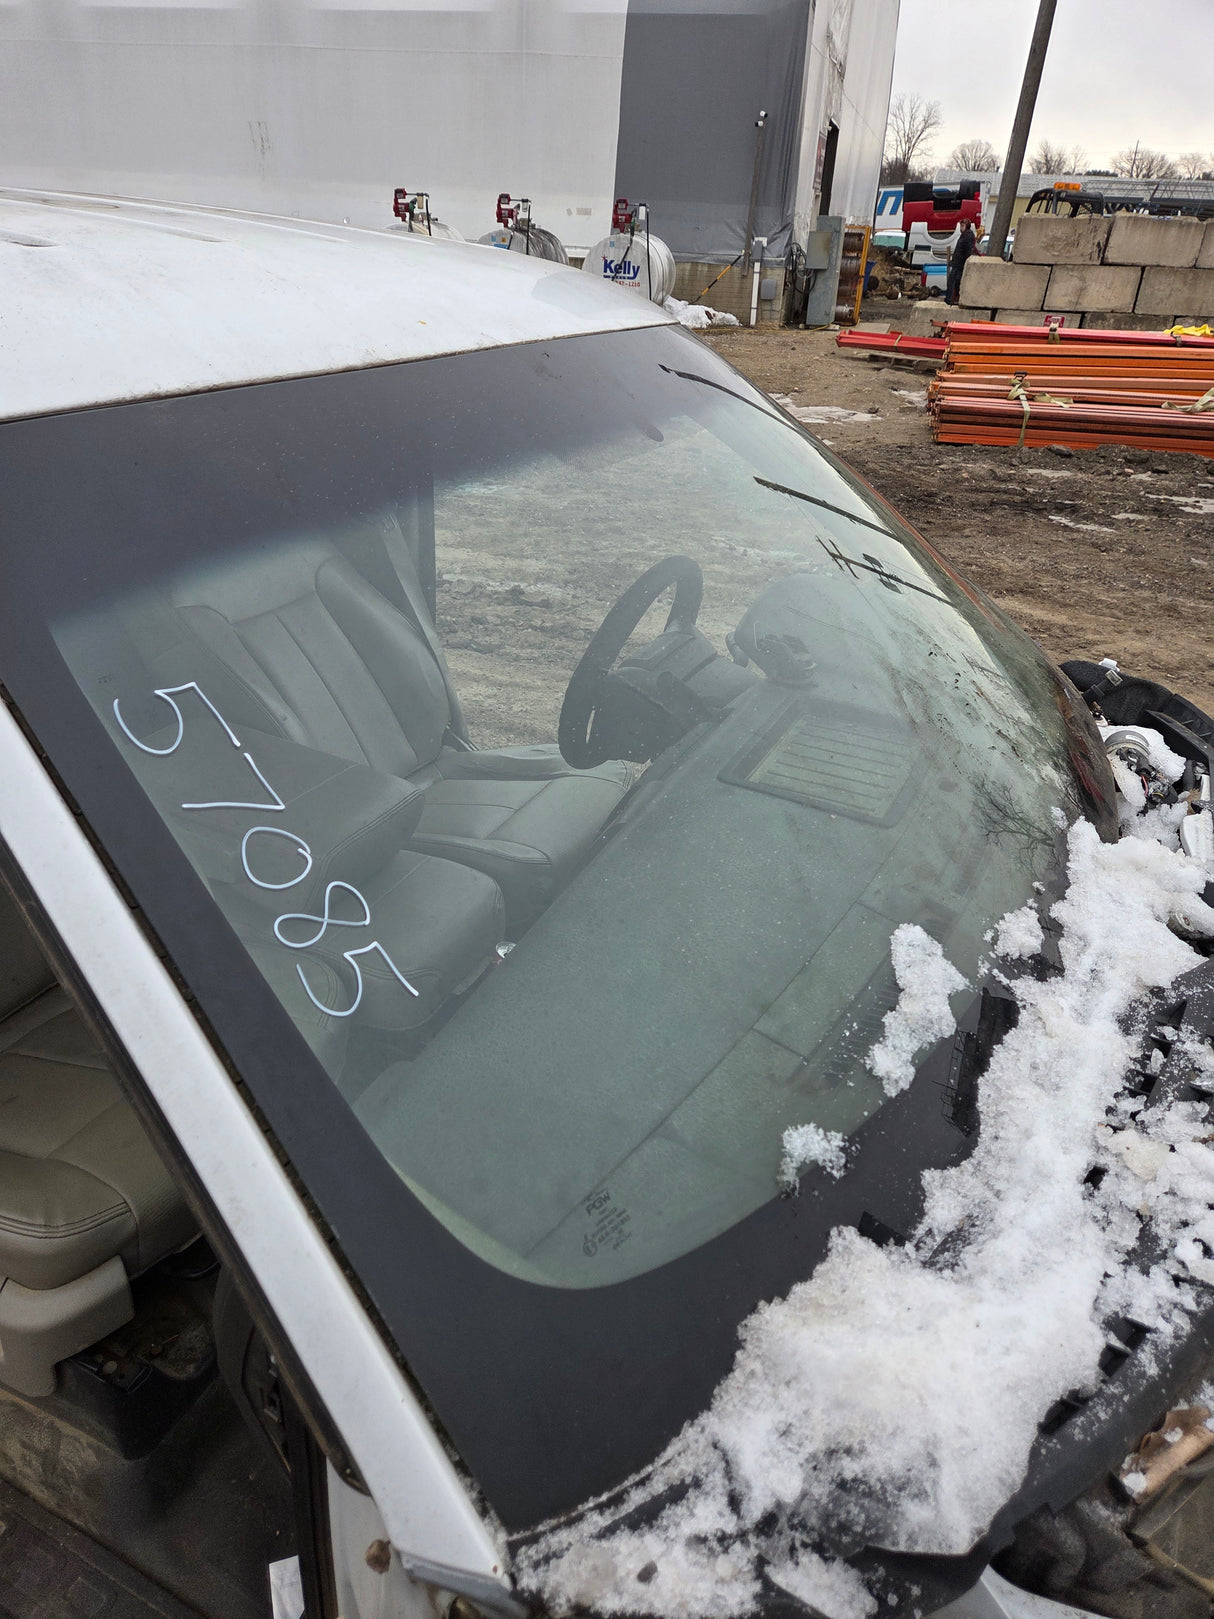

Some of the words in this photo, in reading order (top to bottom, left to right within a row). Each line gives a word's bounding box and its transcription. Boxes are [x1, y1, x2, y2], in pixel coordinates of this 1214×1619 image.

[603, 259, 640, 280] Kelly
[112, 681, 419, 1017] 57085
[585, 1189, 611, 1216] PGW
